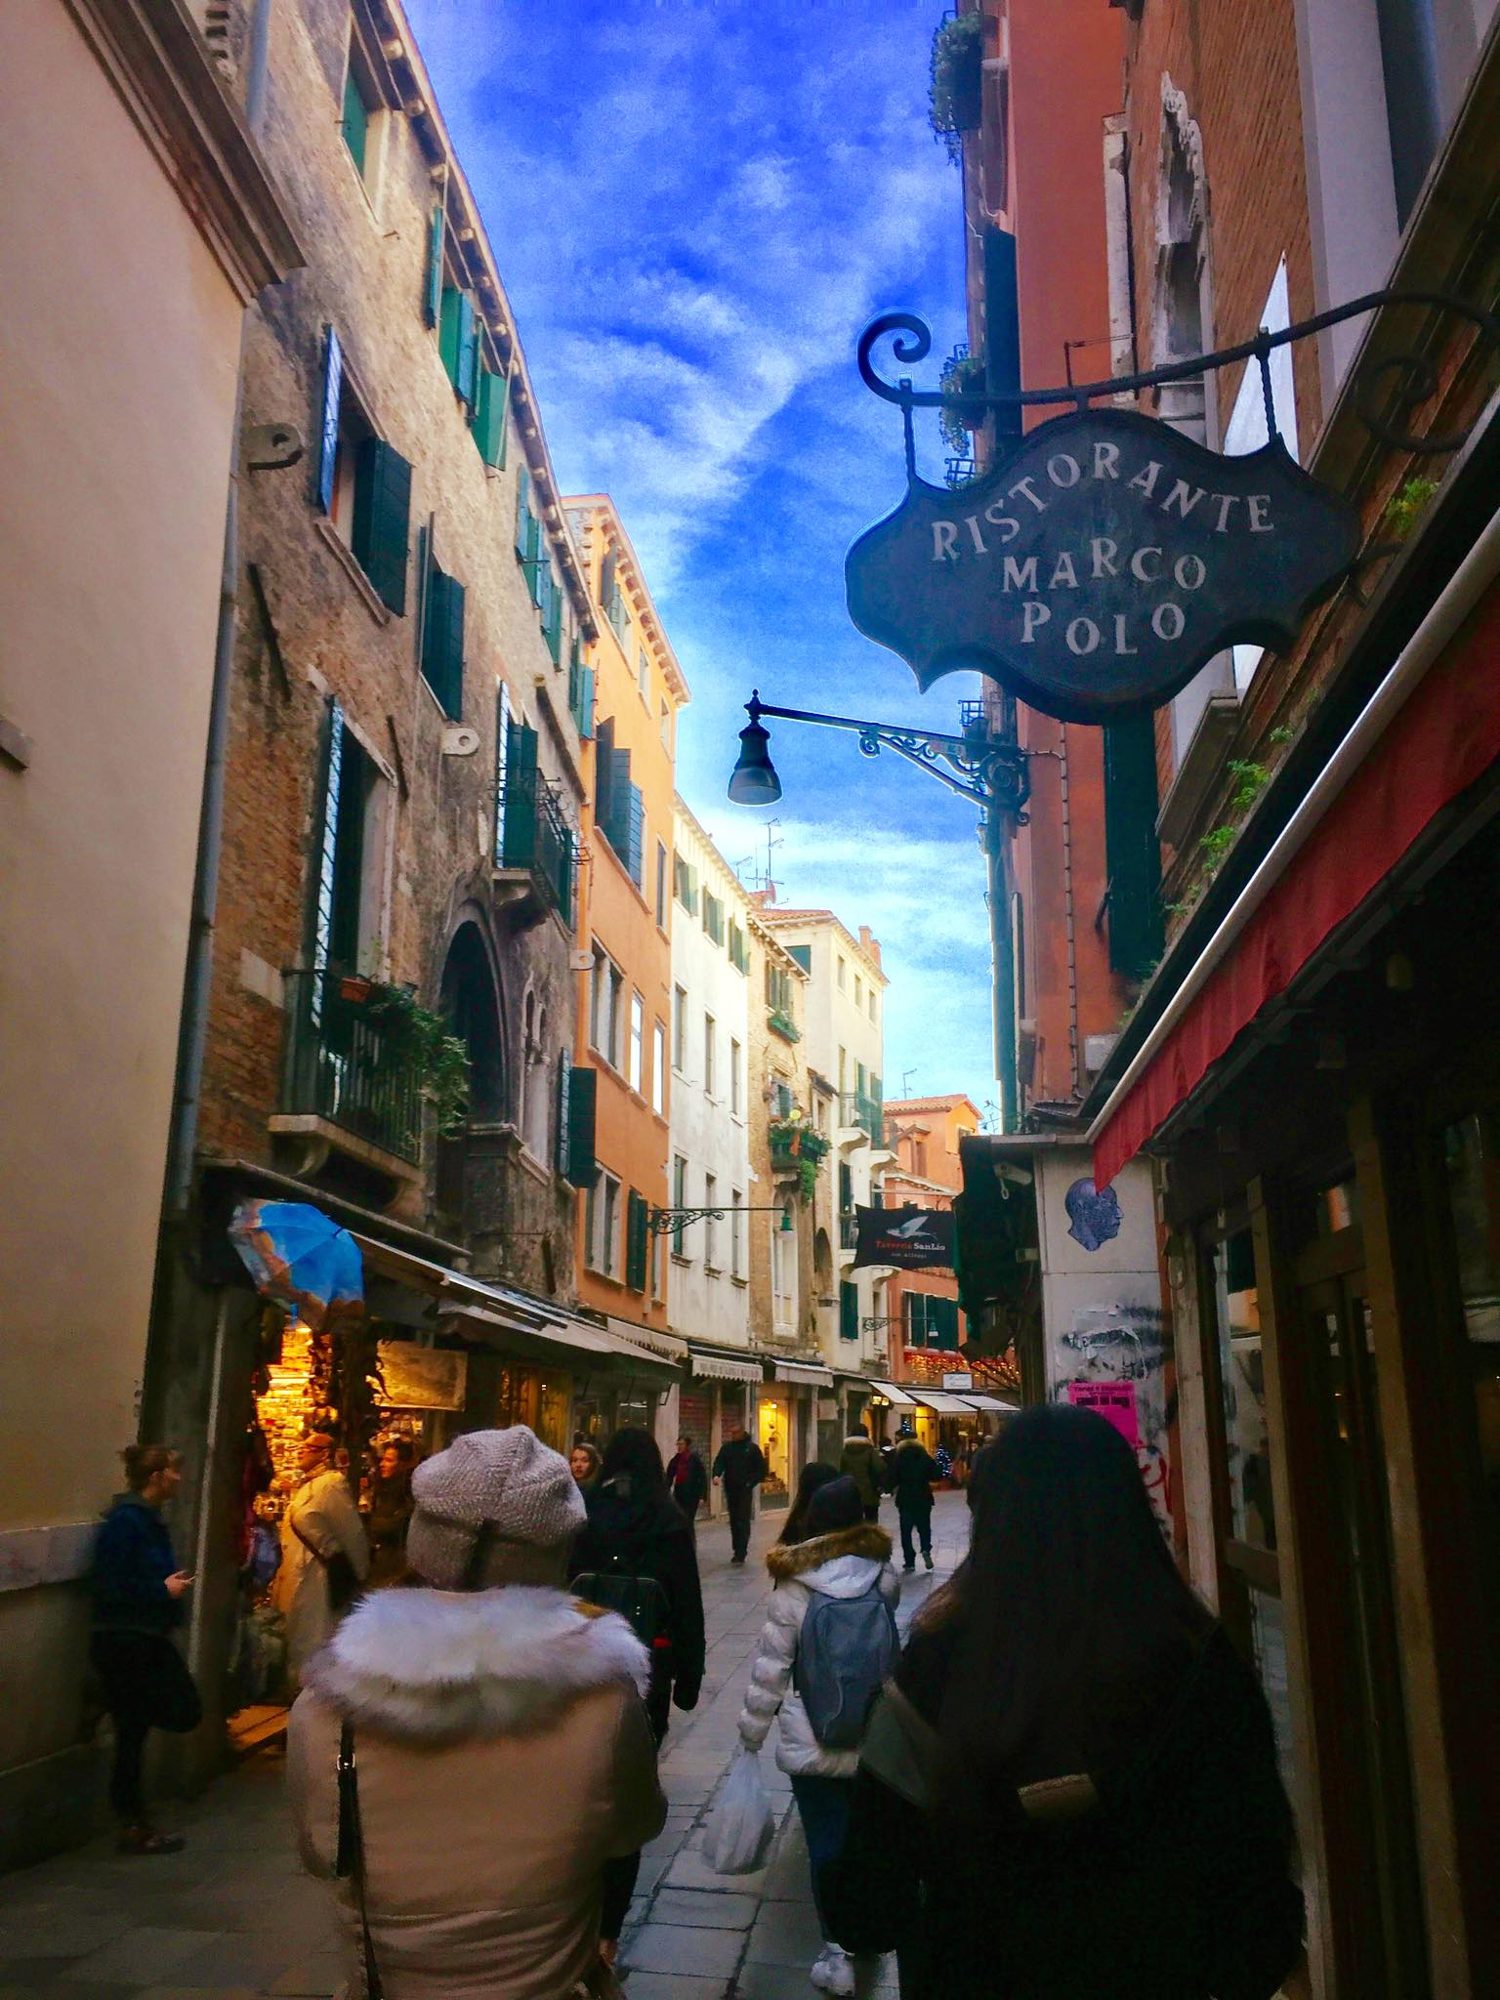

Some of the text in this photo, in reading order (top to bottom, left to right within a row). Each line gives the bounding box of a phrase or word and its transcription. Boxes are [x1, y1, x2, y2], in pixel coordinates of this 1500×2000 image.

[931, 442, 1274, 561] RISTORANTE
[1001, 538, 1206, 593] MARCO
[1021, 602, 1185, 655] POLO
